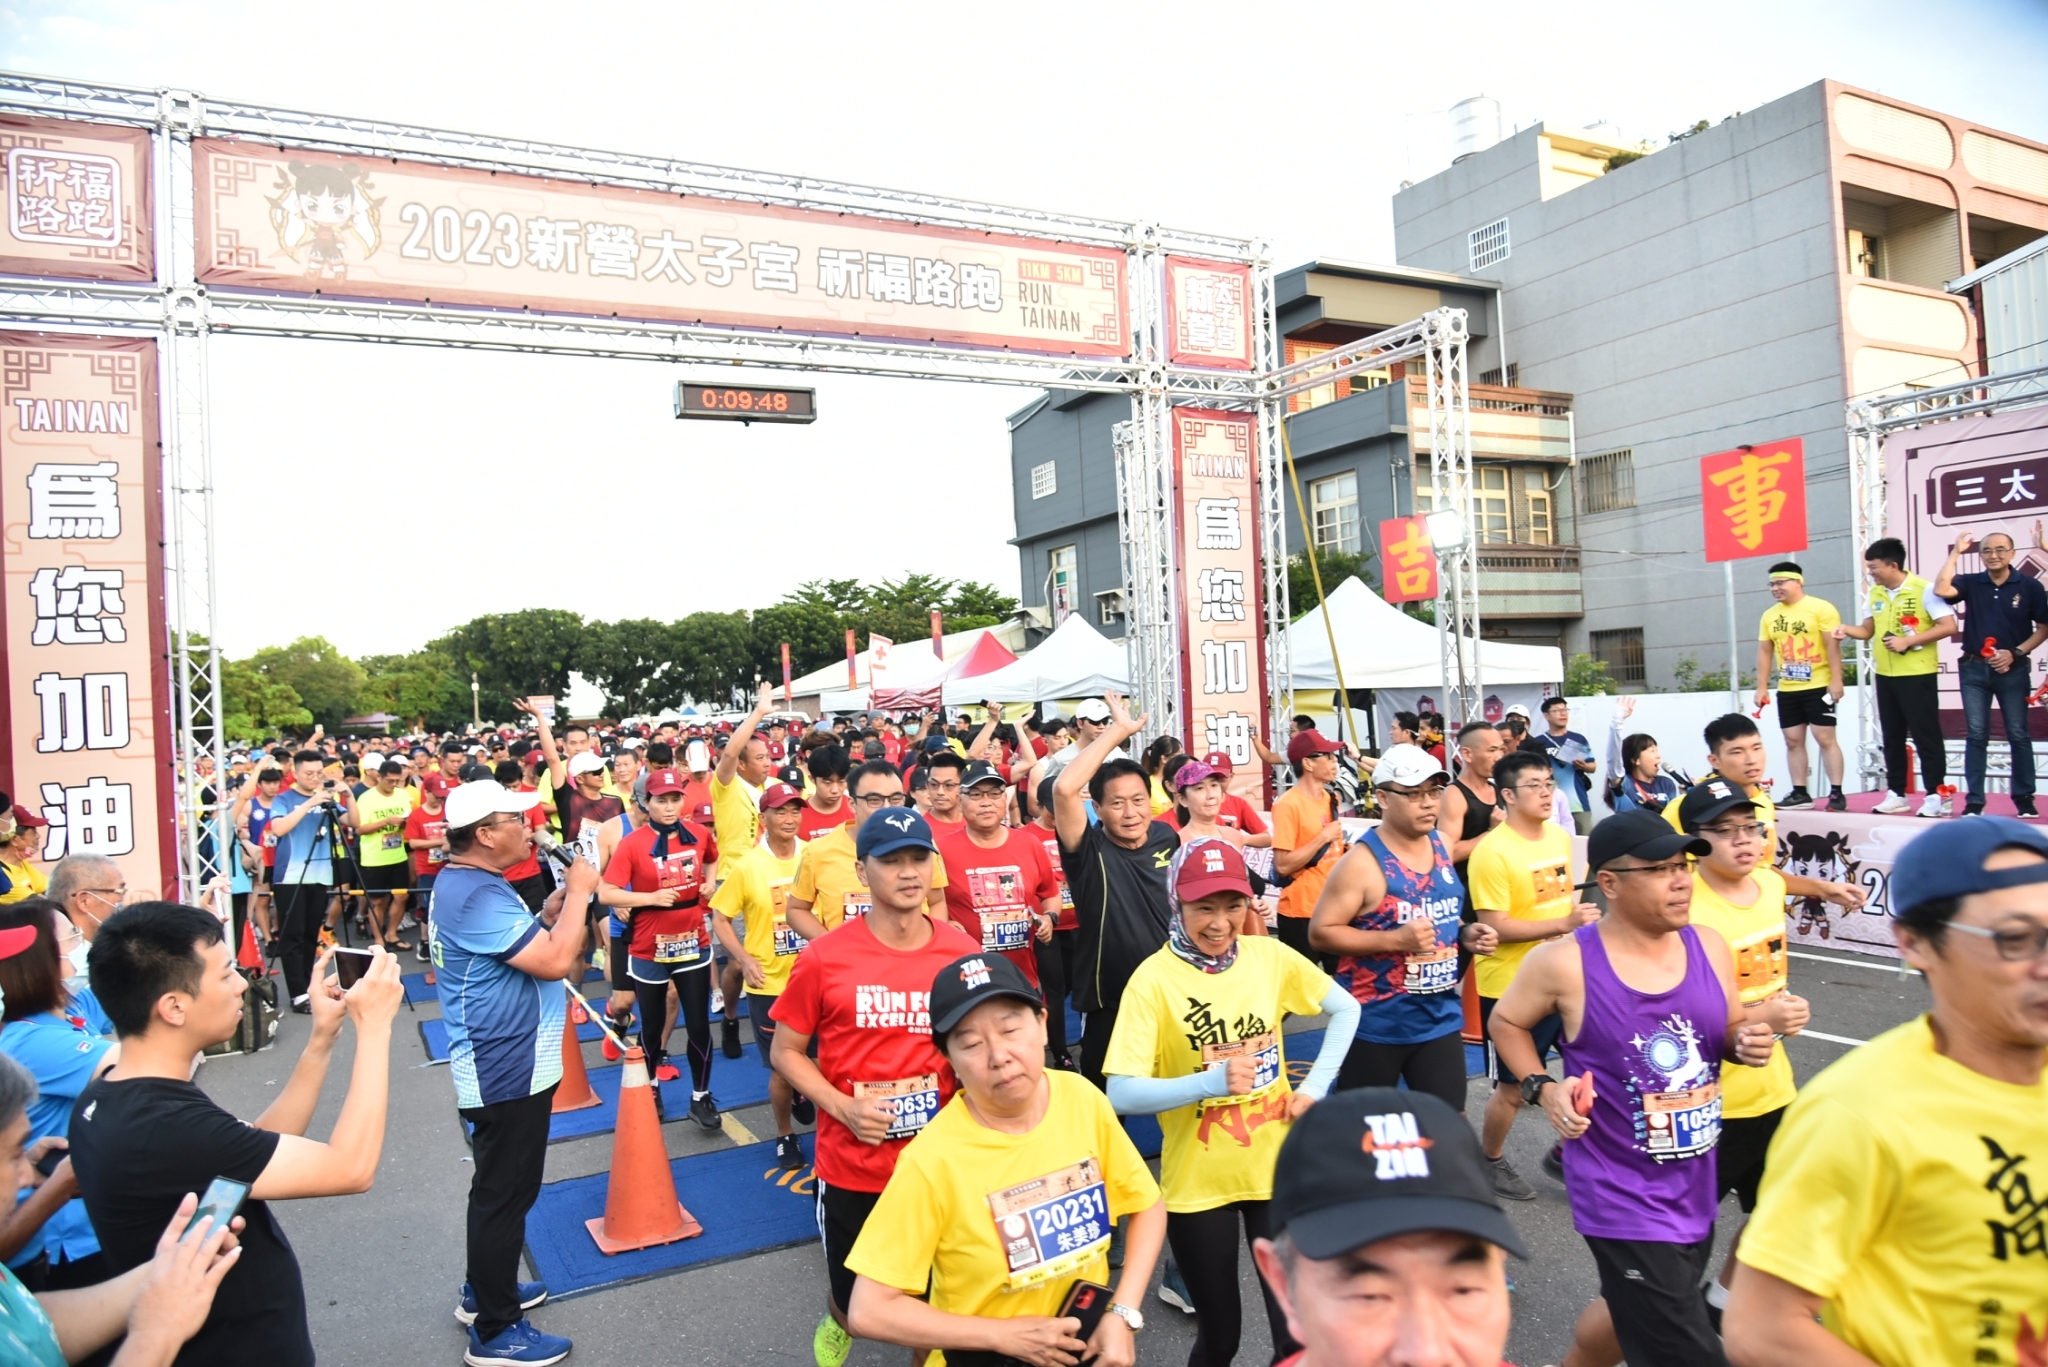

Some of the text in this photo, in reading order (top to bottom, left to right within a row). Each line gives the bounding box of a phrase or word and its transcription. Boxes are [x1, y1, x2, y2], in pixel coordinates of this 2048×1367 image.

[18, 158, 113, 201] 祈福
[18, 194, 114, 239] 路跑
[400, 202, 1003, 312] 2023新營太子宮 祈福路跑
[1020, 261, 1082, 283] 11KM 5KM
[1018, 281, 1053, 305] RUN
[1018, 306, 1081, 332] TAINAN
[14, 398, 129, 434] TAINAN
[701, 389, 788, 412] 0:09:48
[1189, 453, 1245, 479] TAINAN
[1708, 451, 1792, 550] 事
[1954, 469, 2037, 507] 三太
[1387, 521, 1430, 596] 吉
[1397, 896, 1459, 924] Believe
[998, 922, 1028, 935] 10018
[669, 939, 698, 951] 20040
[960, 958, 986, 974] TAI
[855, 991, 906, 1013] RUN
[1363, 1111, 1420, 1146] TAI
[1371, 1146, 1430, 1180] ZIN
[1034, 1188, 1105, 1236] 20231
